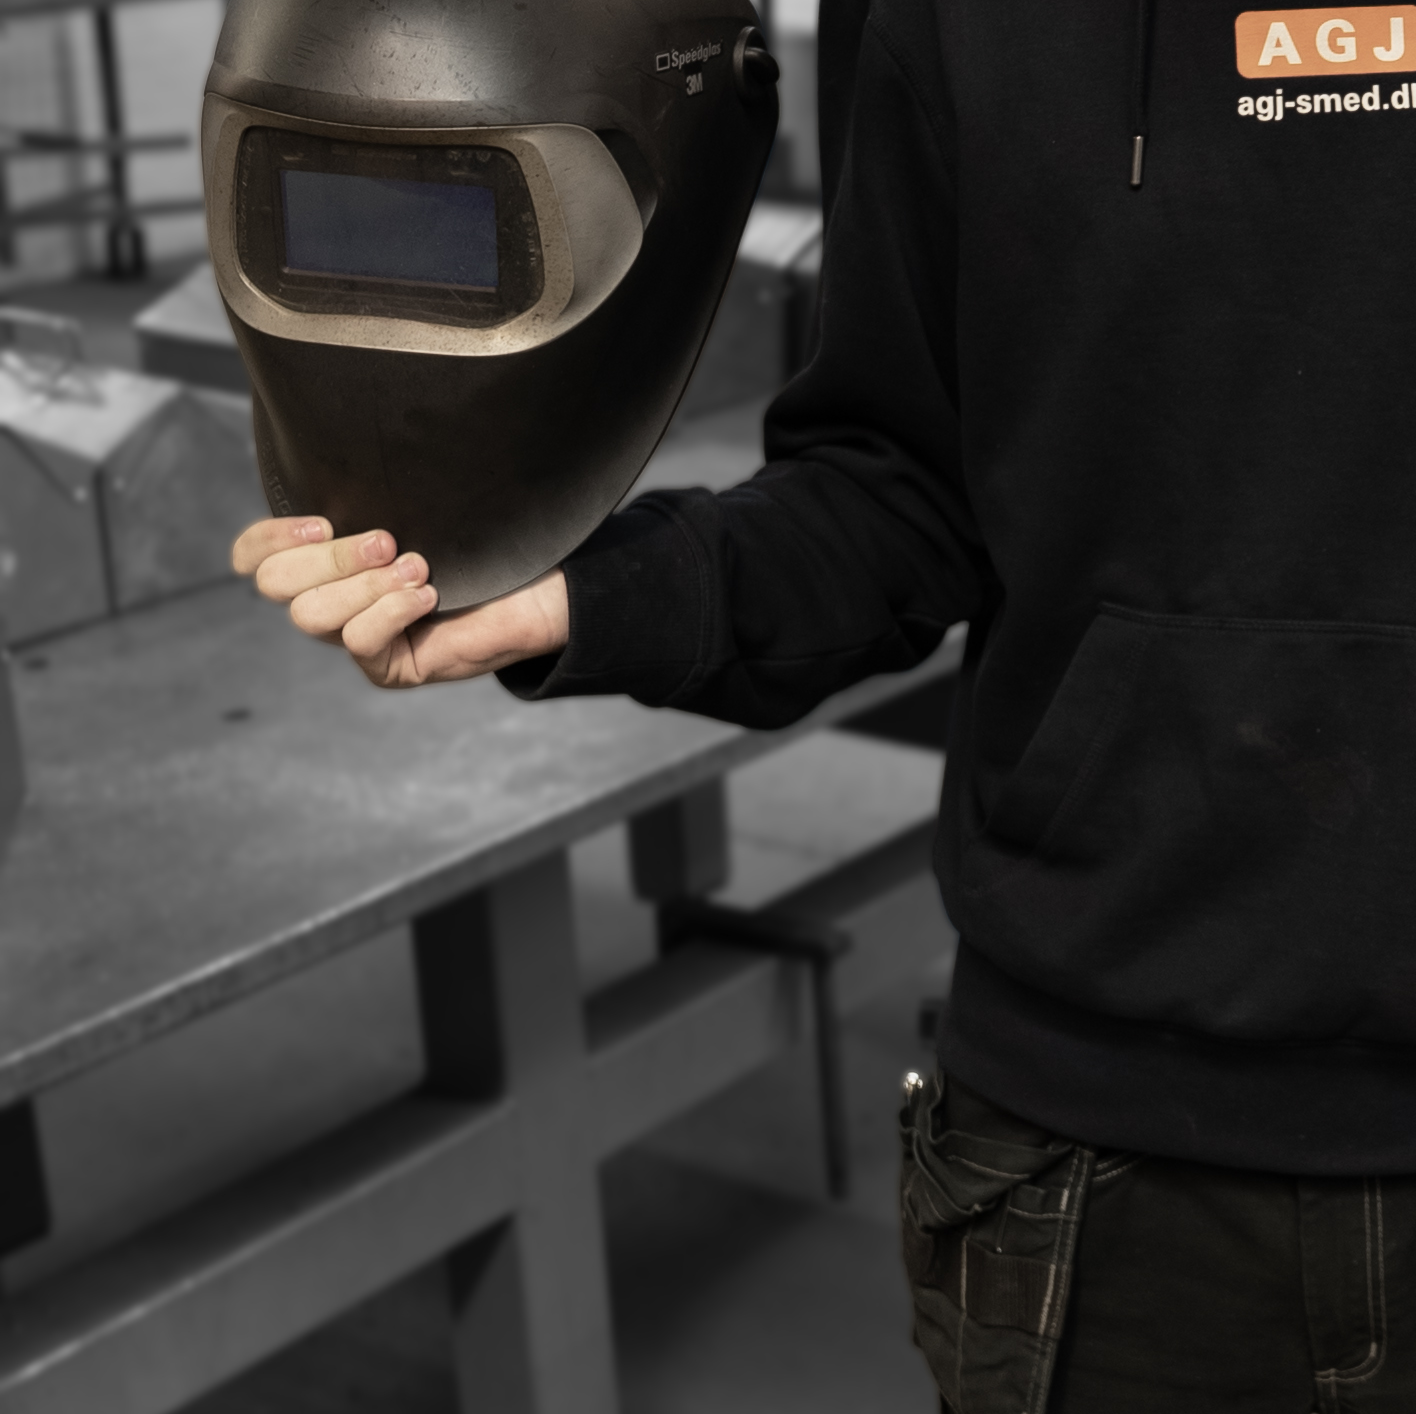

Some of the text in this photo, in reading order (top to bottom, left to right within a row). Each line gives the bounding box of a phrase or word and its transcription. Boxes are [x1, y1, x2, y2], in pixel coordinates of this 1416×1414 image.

[671, 41, 722, 70] Speedglas
[1257, 16, 1405, 67] AGJ
[685, 71, 704, 96] 3M
